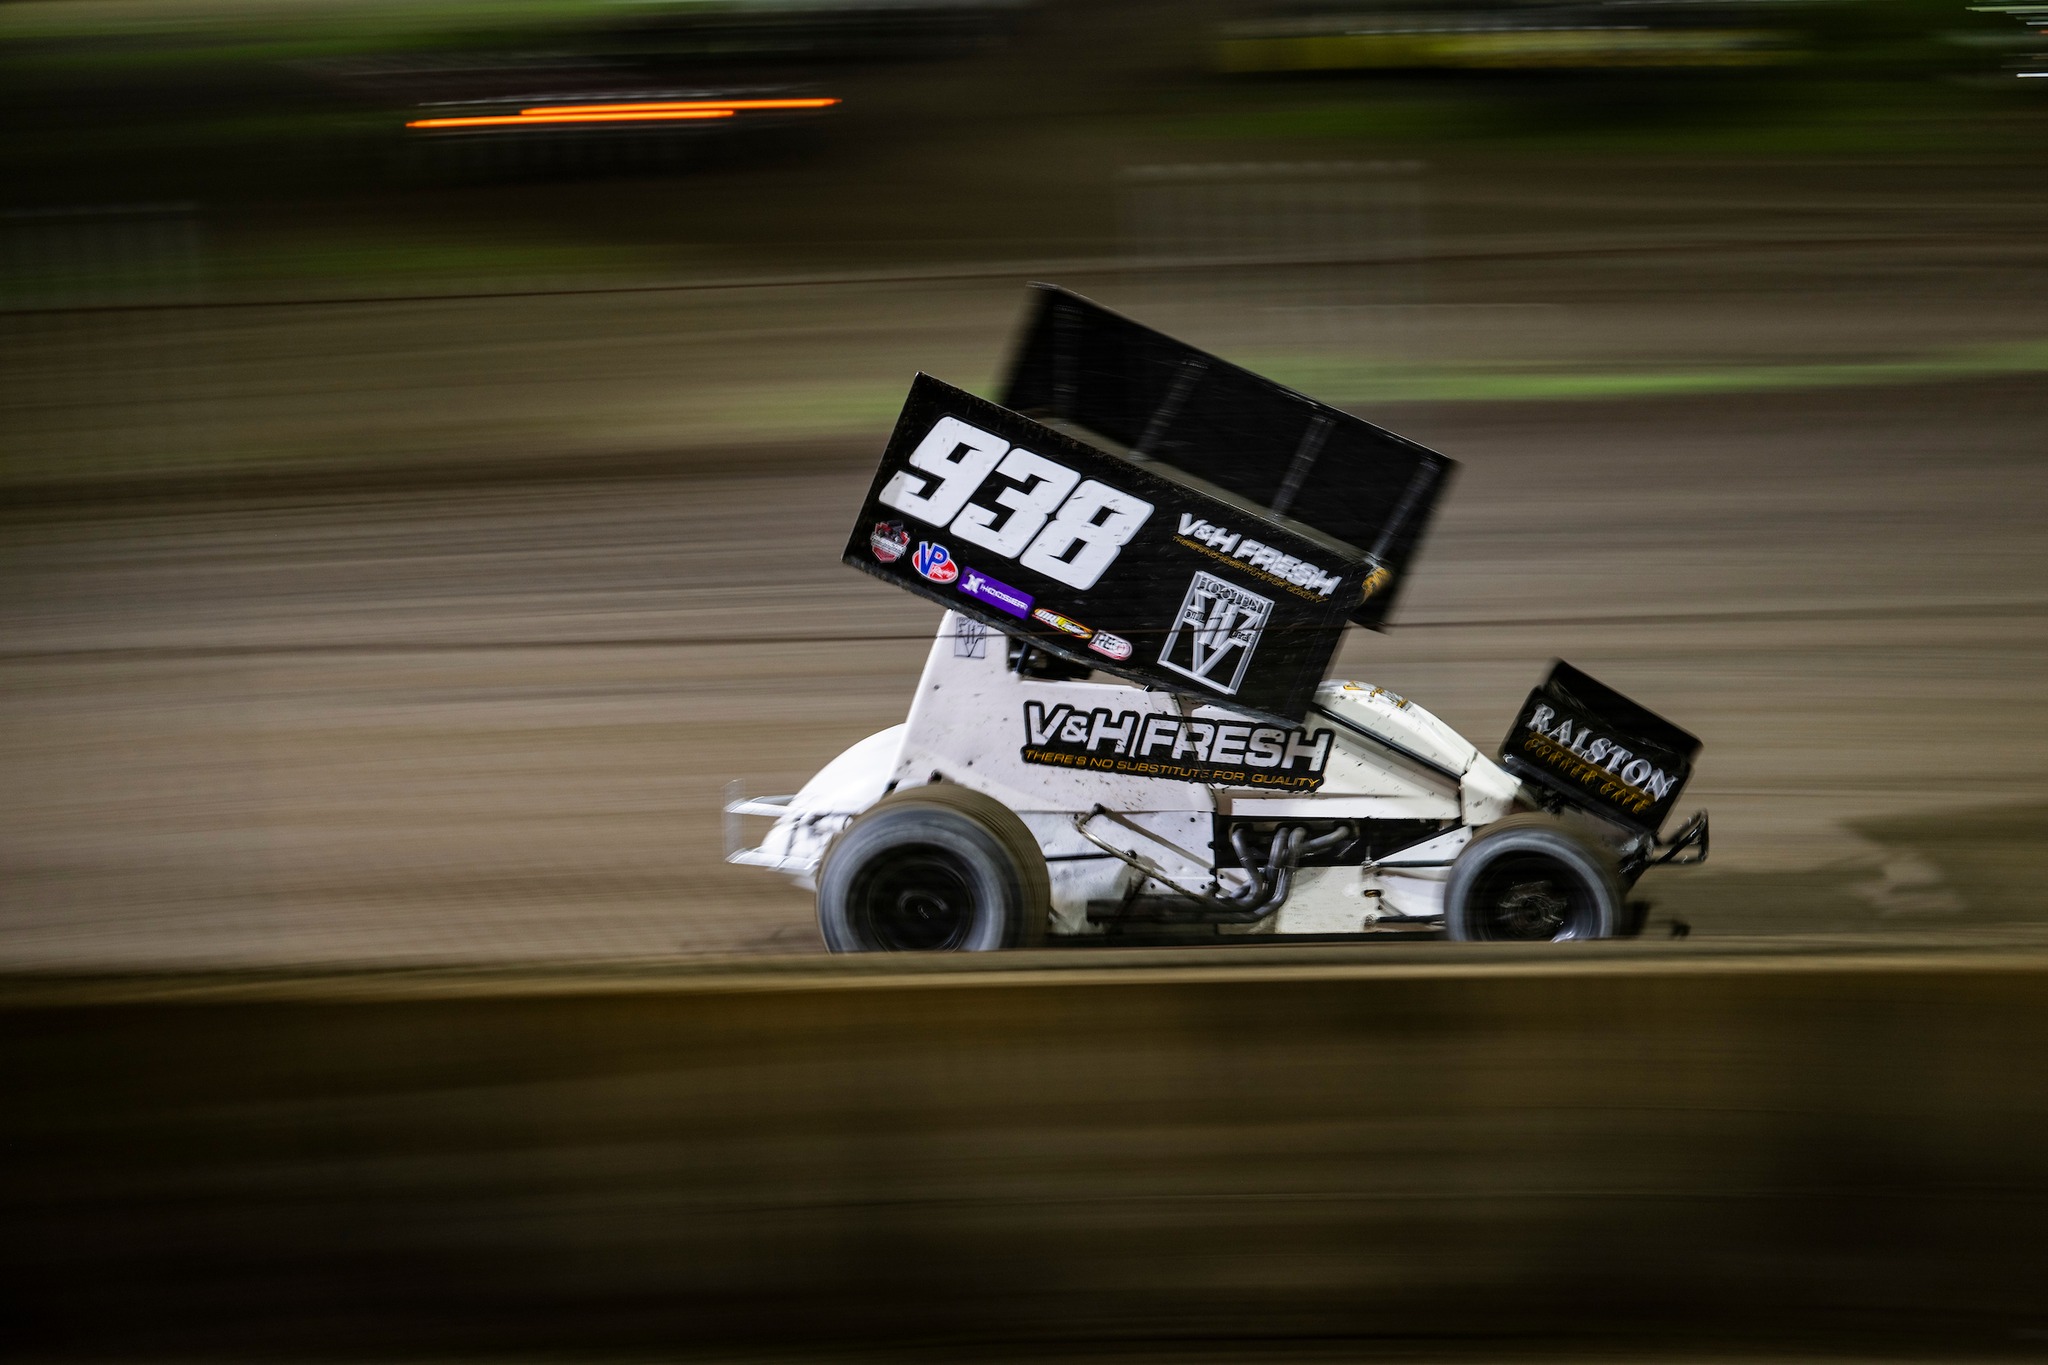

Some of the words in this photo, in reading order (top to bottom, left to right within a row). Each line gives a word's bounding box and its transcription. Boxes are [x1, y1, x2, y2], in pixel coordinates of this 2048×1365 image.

[879, 416, 1155, 591] 938
[919, 541, 950, 576] VP
[1178, 513, 1242, 553] V&H
[1233, 538, 1342, 596] FRESH
[1266, 575, 1284, 588] FOR
[1025, 750, 1087, 766] THERE'S
[1090, 758, 1113, 769] NO
[1116, 761, 1208, 778] SUBSTITUTE
[1213, 770, 1245, 781] FOR
[1251, 773, 1320, 788] QUALITY
[1028, 704, 1135, 754] V&H
[1140, 718, 1331, 772] FRESH
[1525, 703, 1679, 802] RALSTON
[1524, 738, 1598, 785] CORNER
[1600, 781, 1650, 815] CAFE
